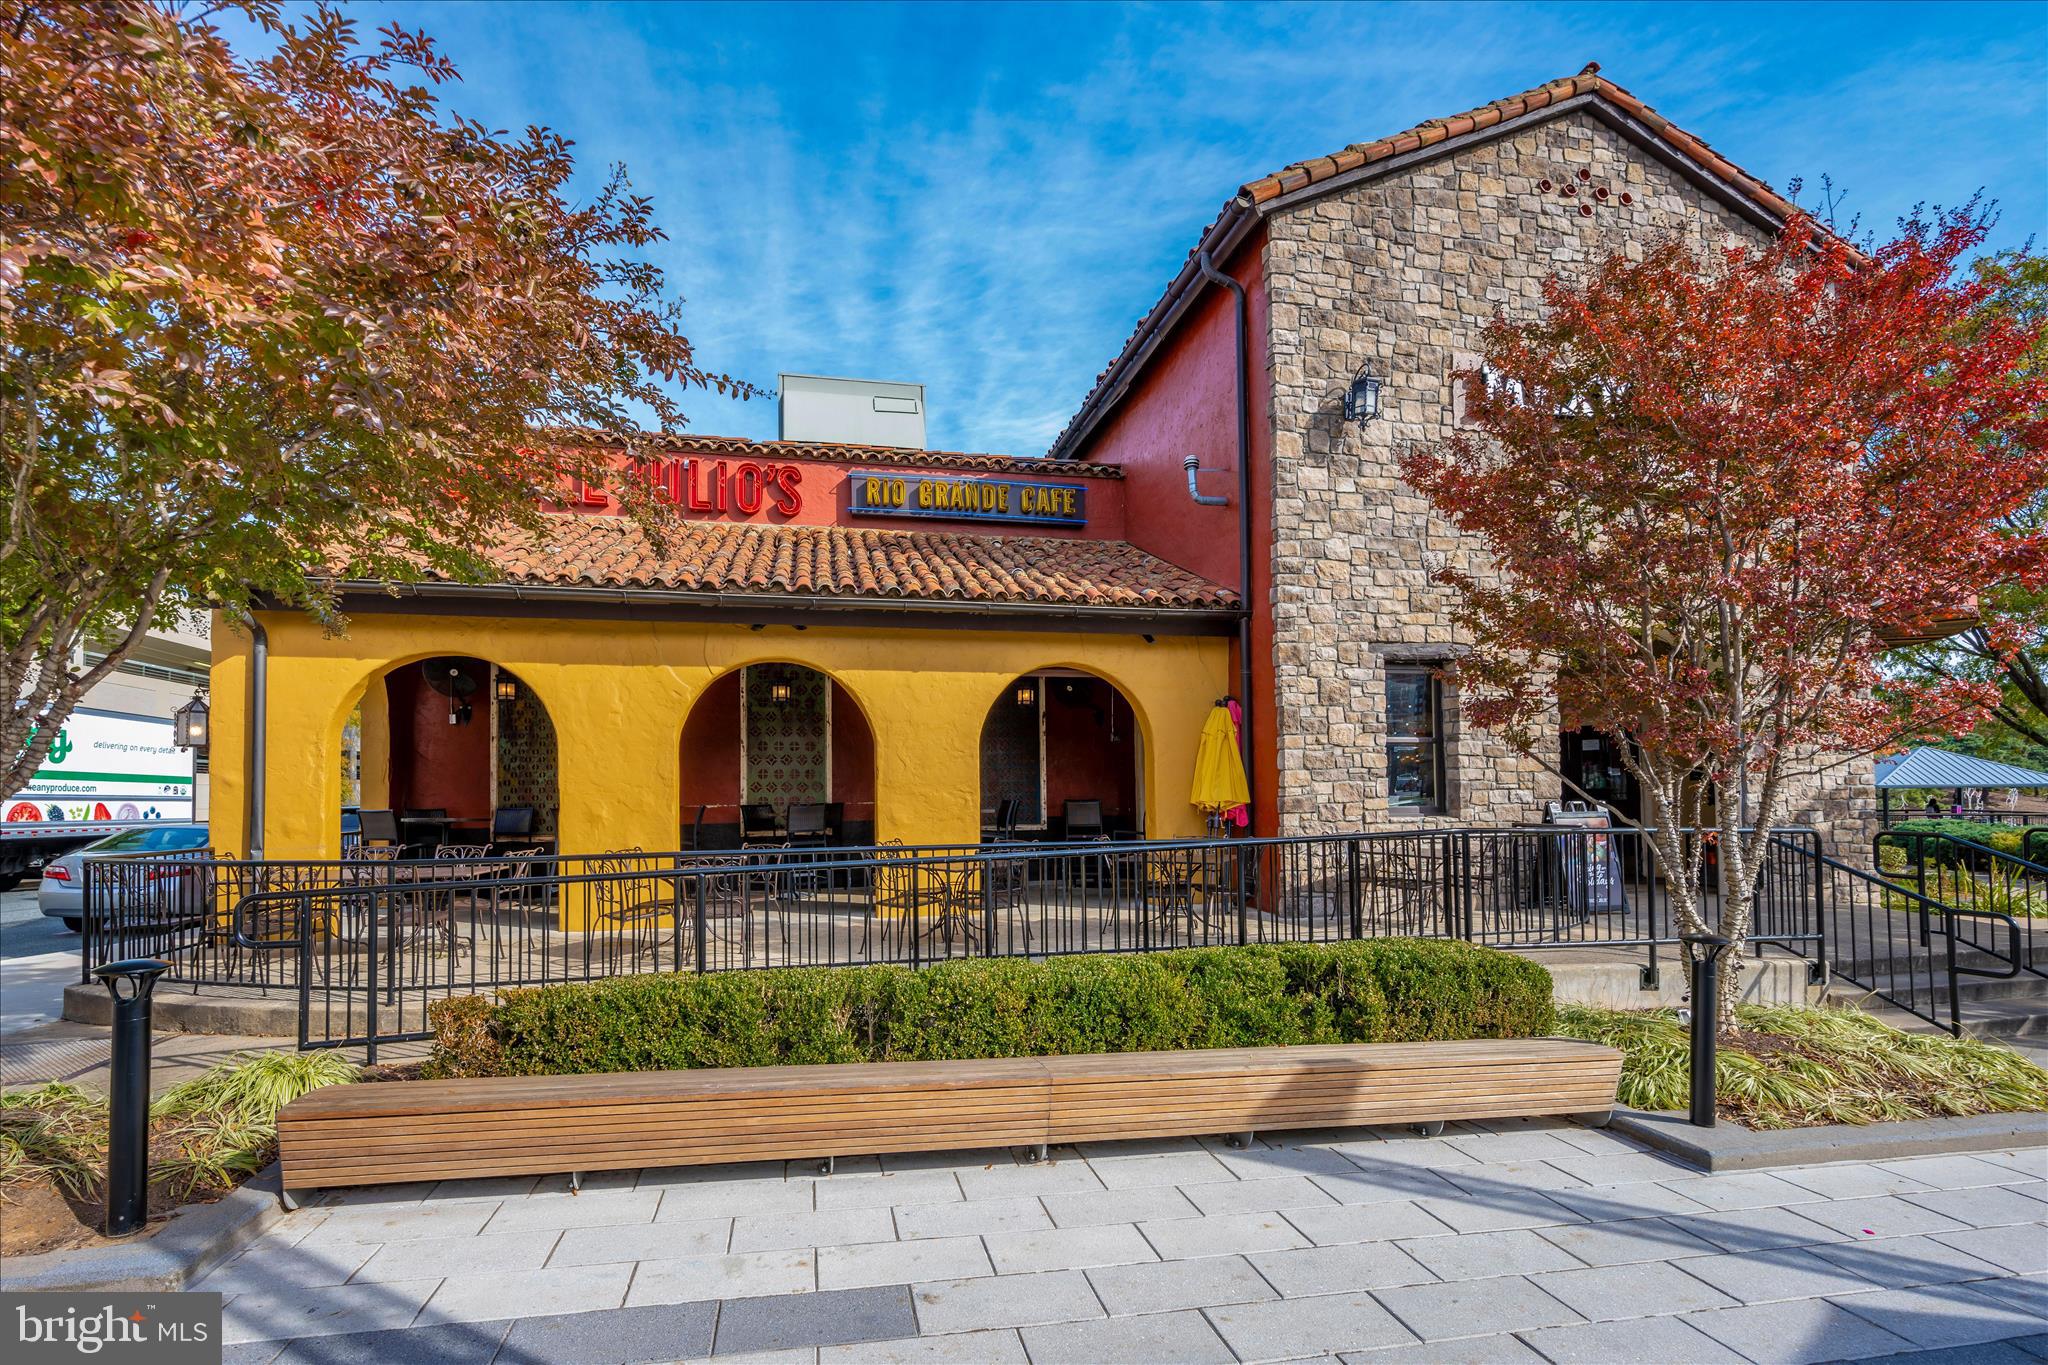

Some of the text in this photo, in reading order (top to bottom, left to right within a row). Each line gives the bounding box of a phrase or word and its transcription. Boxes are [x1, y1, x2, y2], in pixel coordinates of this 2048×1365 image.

[865, 476, 1077, 516] RIO GRANDE CAFE
[93, 741, 128, 753] delivering
[139, 746, 157, 755] every
